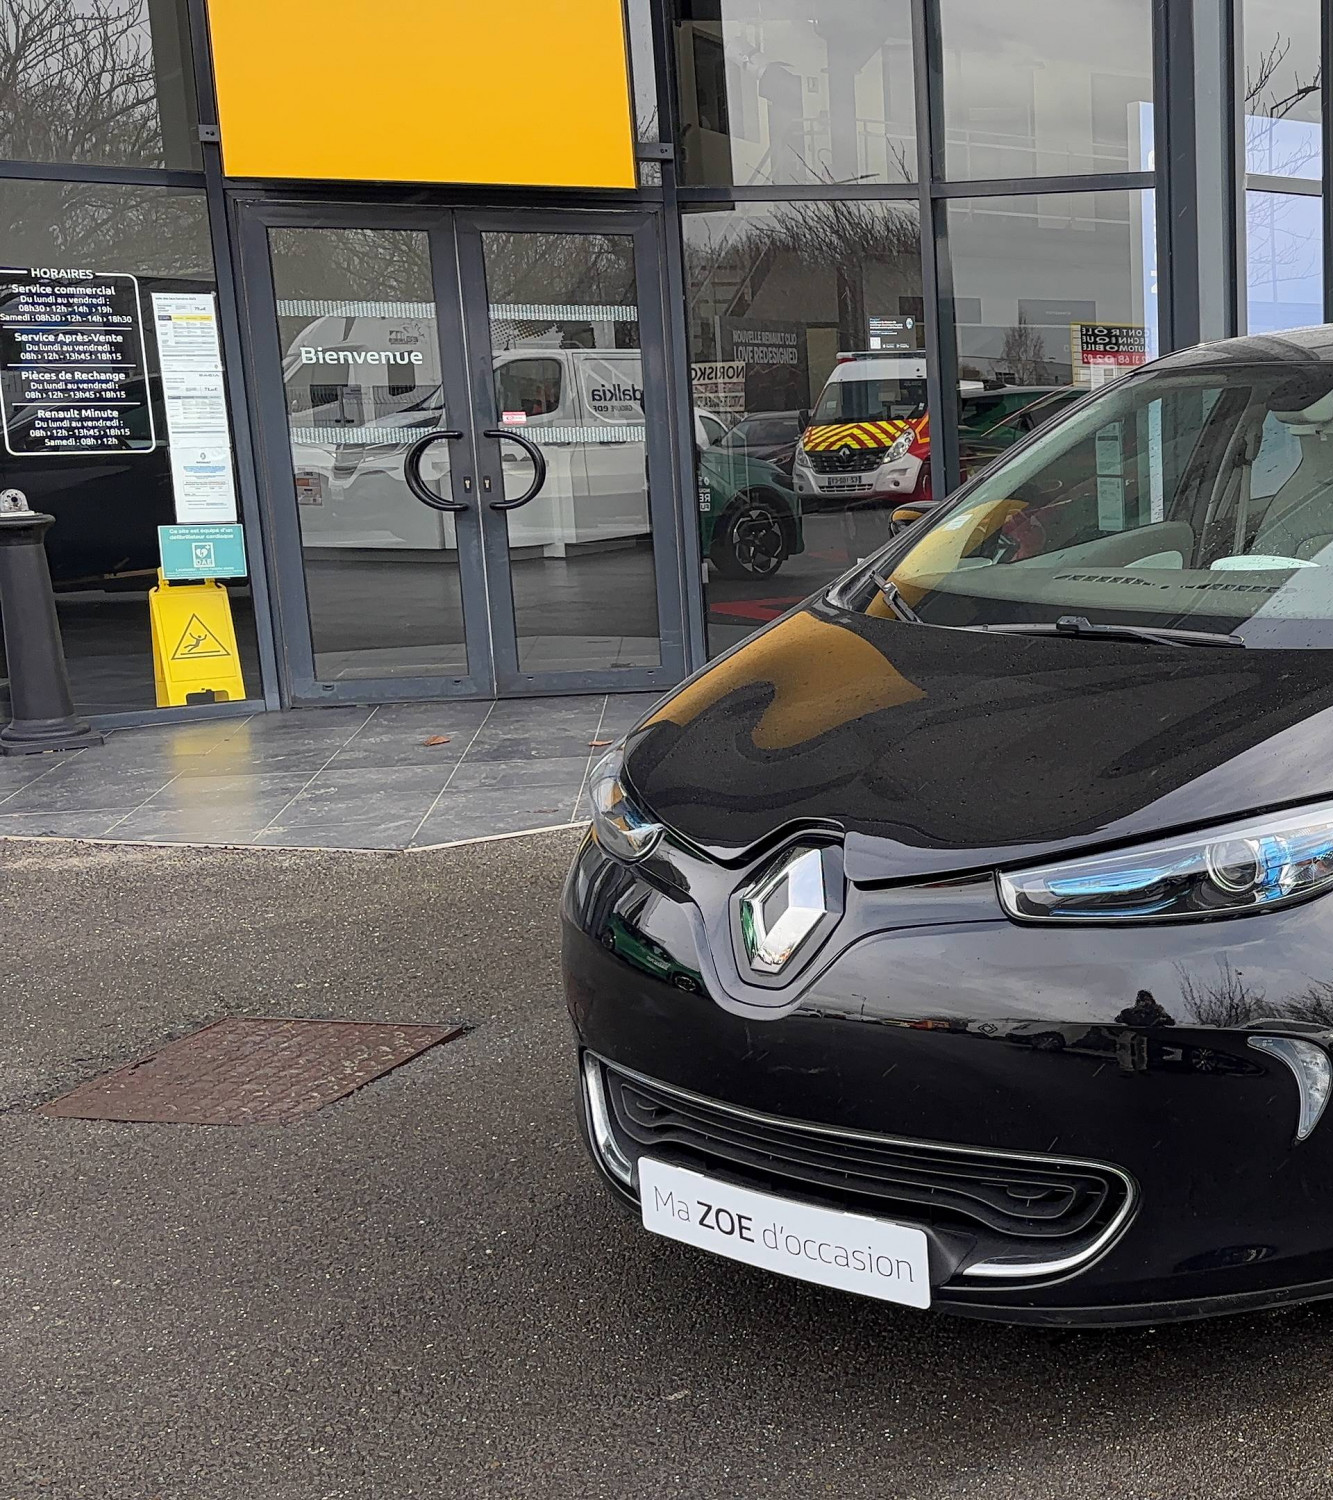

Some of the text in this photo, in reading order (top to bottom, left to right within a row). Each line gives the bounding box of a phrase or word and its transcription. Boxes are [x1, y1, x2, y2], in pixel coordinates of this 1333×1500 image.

[31, 268, 94, 279] HORAIRES
[11, 284, 116, 295] Service commercial
[20, 295, 33, 303] Du
[69, 296, 105, 304] vendredi
[18, 304, 45, 312] 08h30
[73, 305, 89, 313] 14h
[0, 313, 30, 321] Samedi
[14, 333, 123, 343] Service Après-Vente
[26, 343, 38, 351] Du
[40, 343, 61, 351] lundi
[300, 347, 423, 365] Bienvenue
[733, 346, 798, 364] LOVE REDESIGNED
[21, 371, 126, 381] Pièces de Rechange
[37, 409, 119, 418] Renault Minute
[35, 420, 47, 428] Du
[82, 419, 119, 427] vendredi
[30, 429, 46, 437] 08h
[74, 428, 99, 436] 13h45
[105, 428, 131, 436] 18h15
[44, 438, 75, 446] Samedi
[80, 438, 96, 446] 08h
[653, 1185, 914, 1283] Ma ZOE d'occasion
